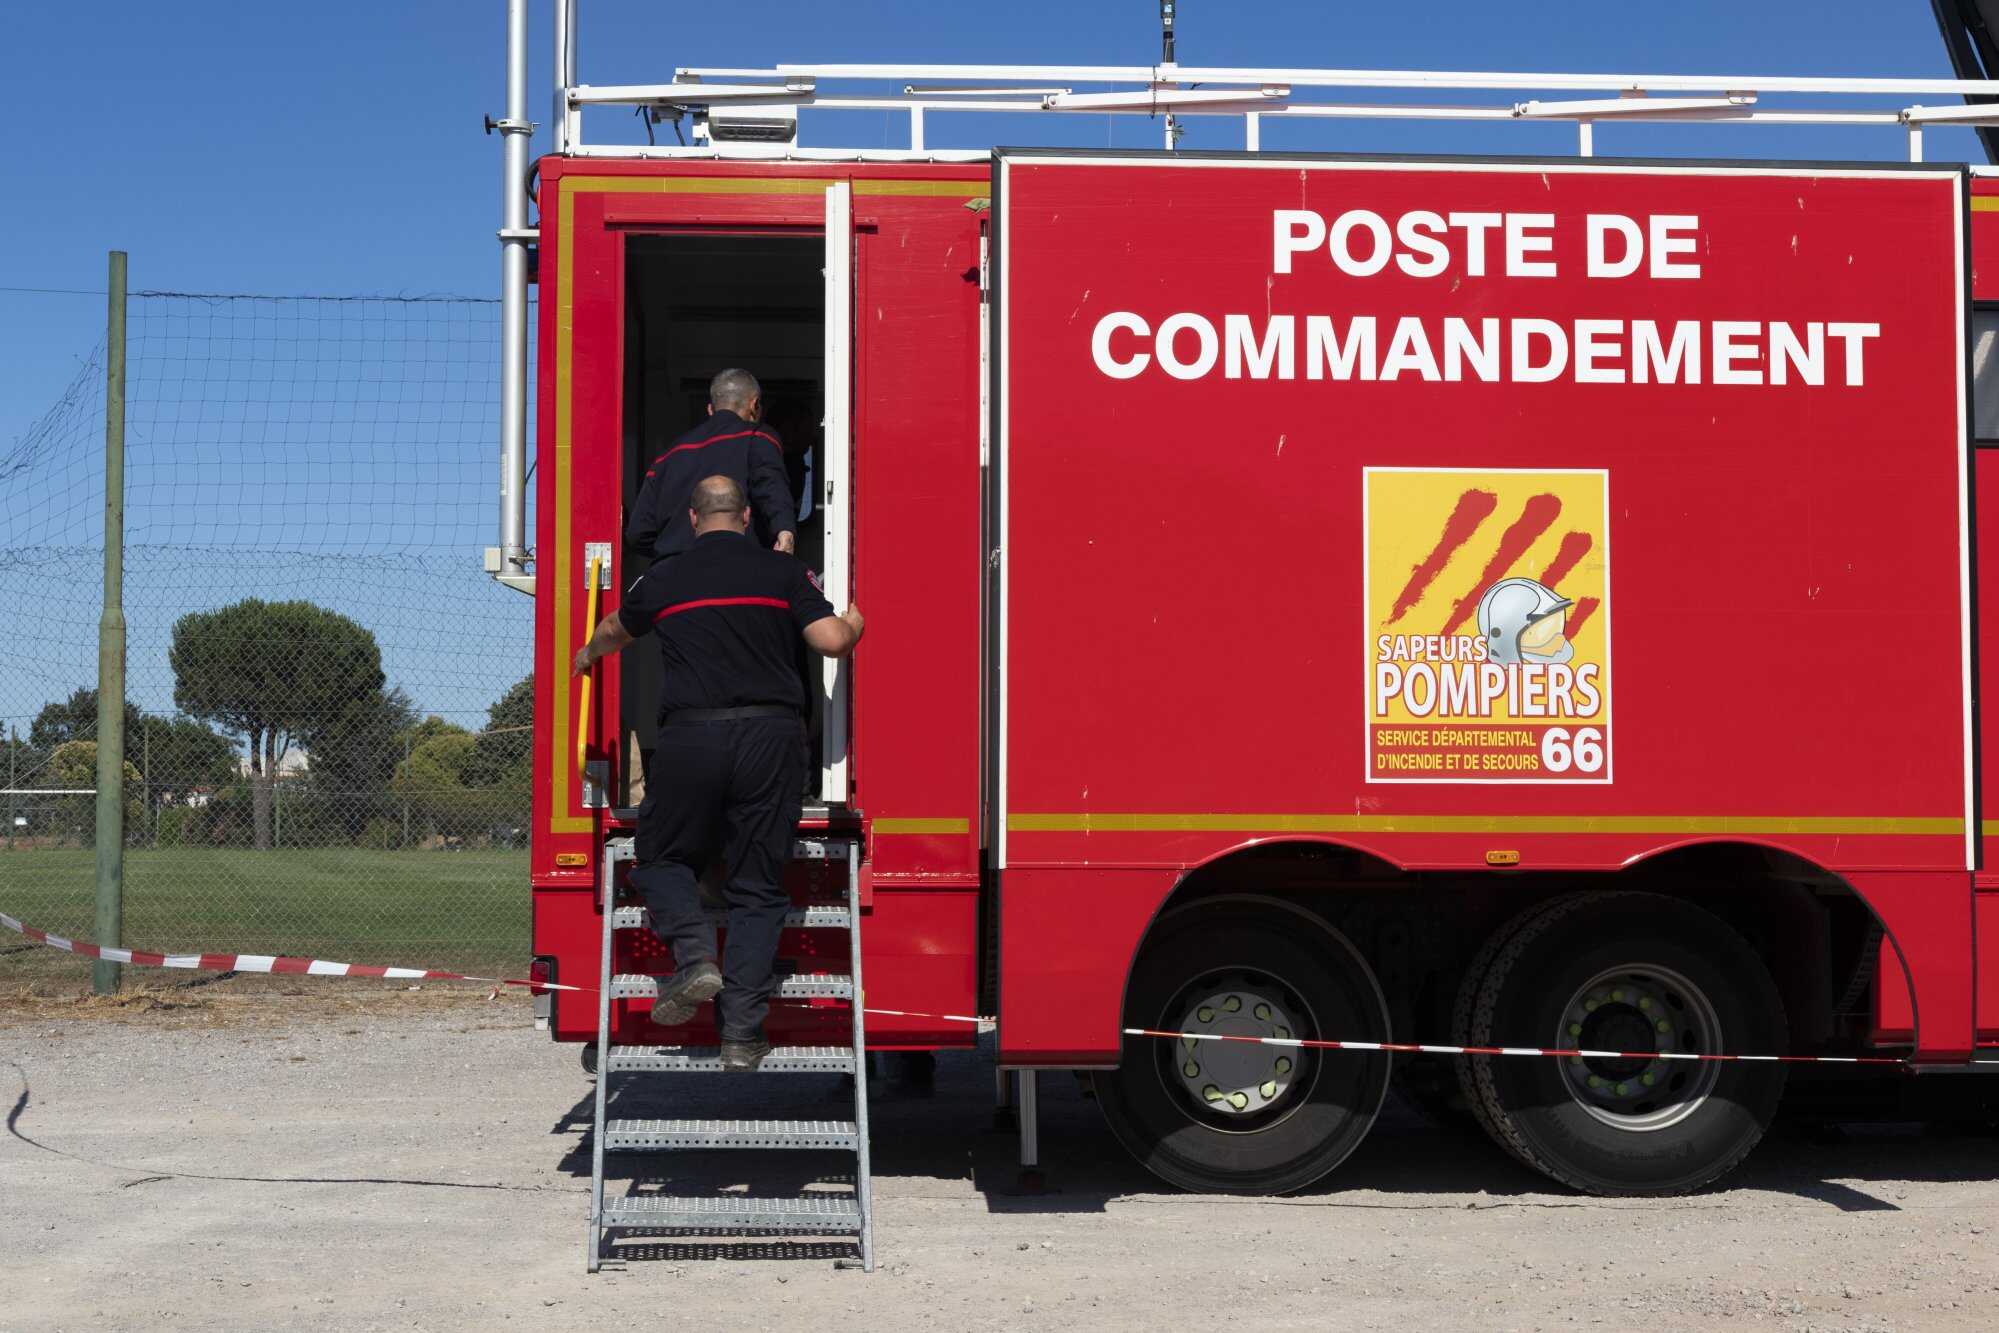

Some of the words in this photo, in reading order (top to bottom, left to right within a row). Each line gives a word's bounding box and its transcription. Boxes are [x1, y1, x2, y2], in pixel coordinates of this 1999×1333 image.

[1273, 208, 1557, 278] POSTE
[1586, 213, 1701, 279] DE
[1091, 310, 1881, 386] COMMANDEMENT
[1377, 635, 1488, 662] SAPEURS
[1376, 662, 1600, 718] POMPIERS
[1377, 730, 1429, 746] SERVICE
[1432, 727, 1536, 747] DÉPARTEMENTAL
[1541, 727, 1603, 772] 66
[1377, 753, 1443, 770] D'INCENDIE
[1446, 754, 1460, 770] ET
[1464, 754, 1480, 770] DE
[1483, 754, 1539, 771] SECOURS
